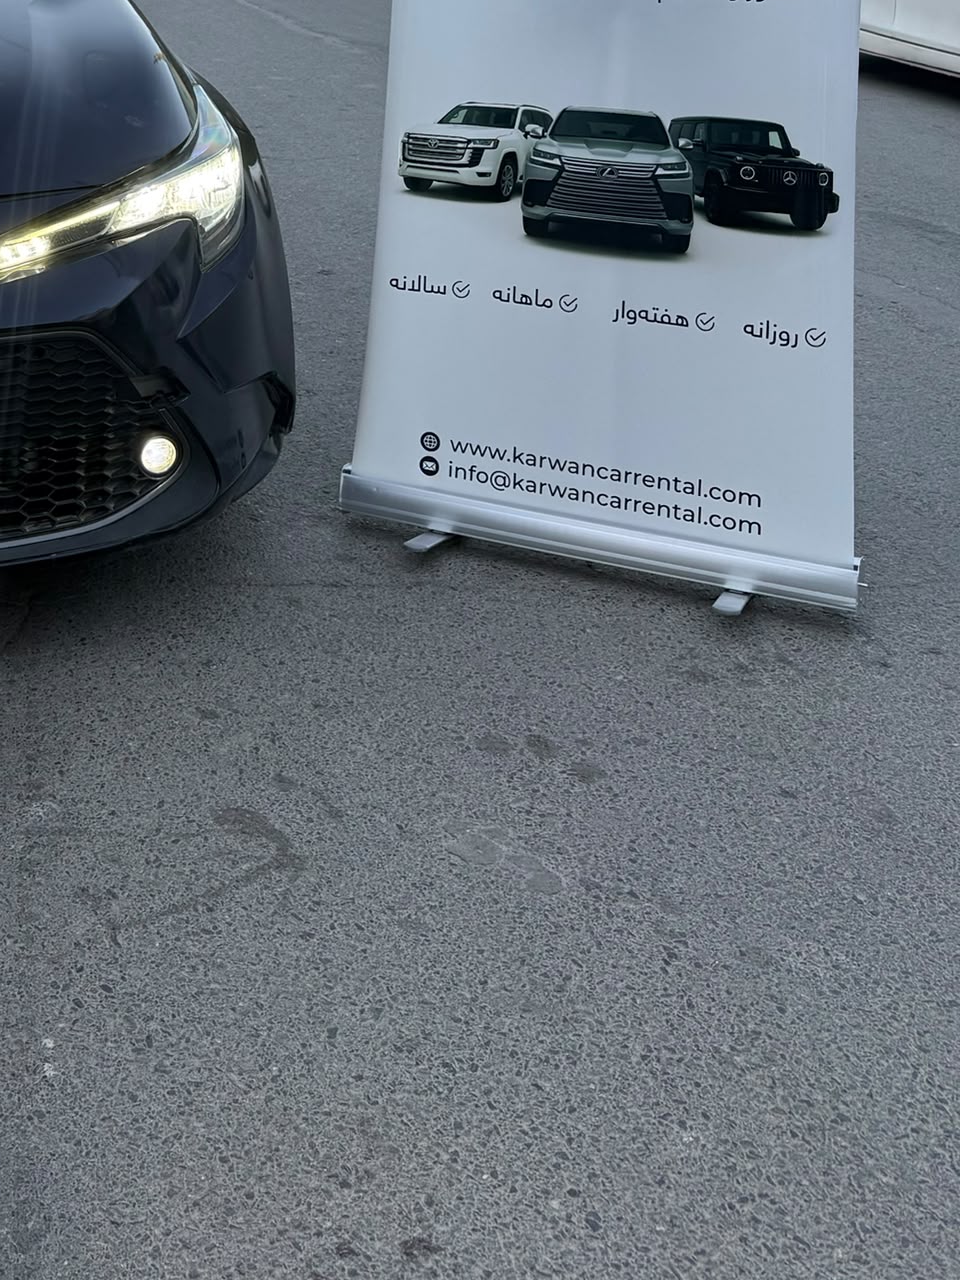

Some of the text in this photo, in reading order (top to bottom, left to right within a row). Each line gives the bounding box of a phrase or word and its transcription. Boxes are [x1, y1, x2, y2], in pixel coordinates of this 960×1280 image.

[389, 273, 447, 296] سالانه
[492, 286, 554, 310] ماهانه
[742, 320, 799, 348] روزانه
[449, 437, 762, 509] www.karwancarrental.com
[448, 460, 762, 536] info@karwancarrental.com
